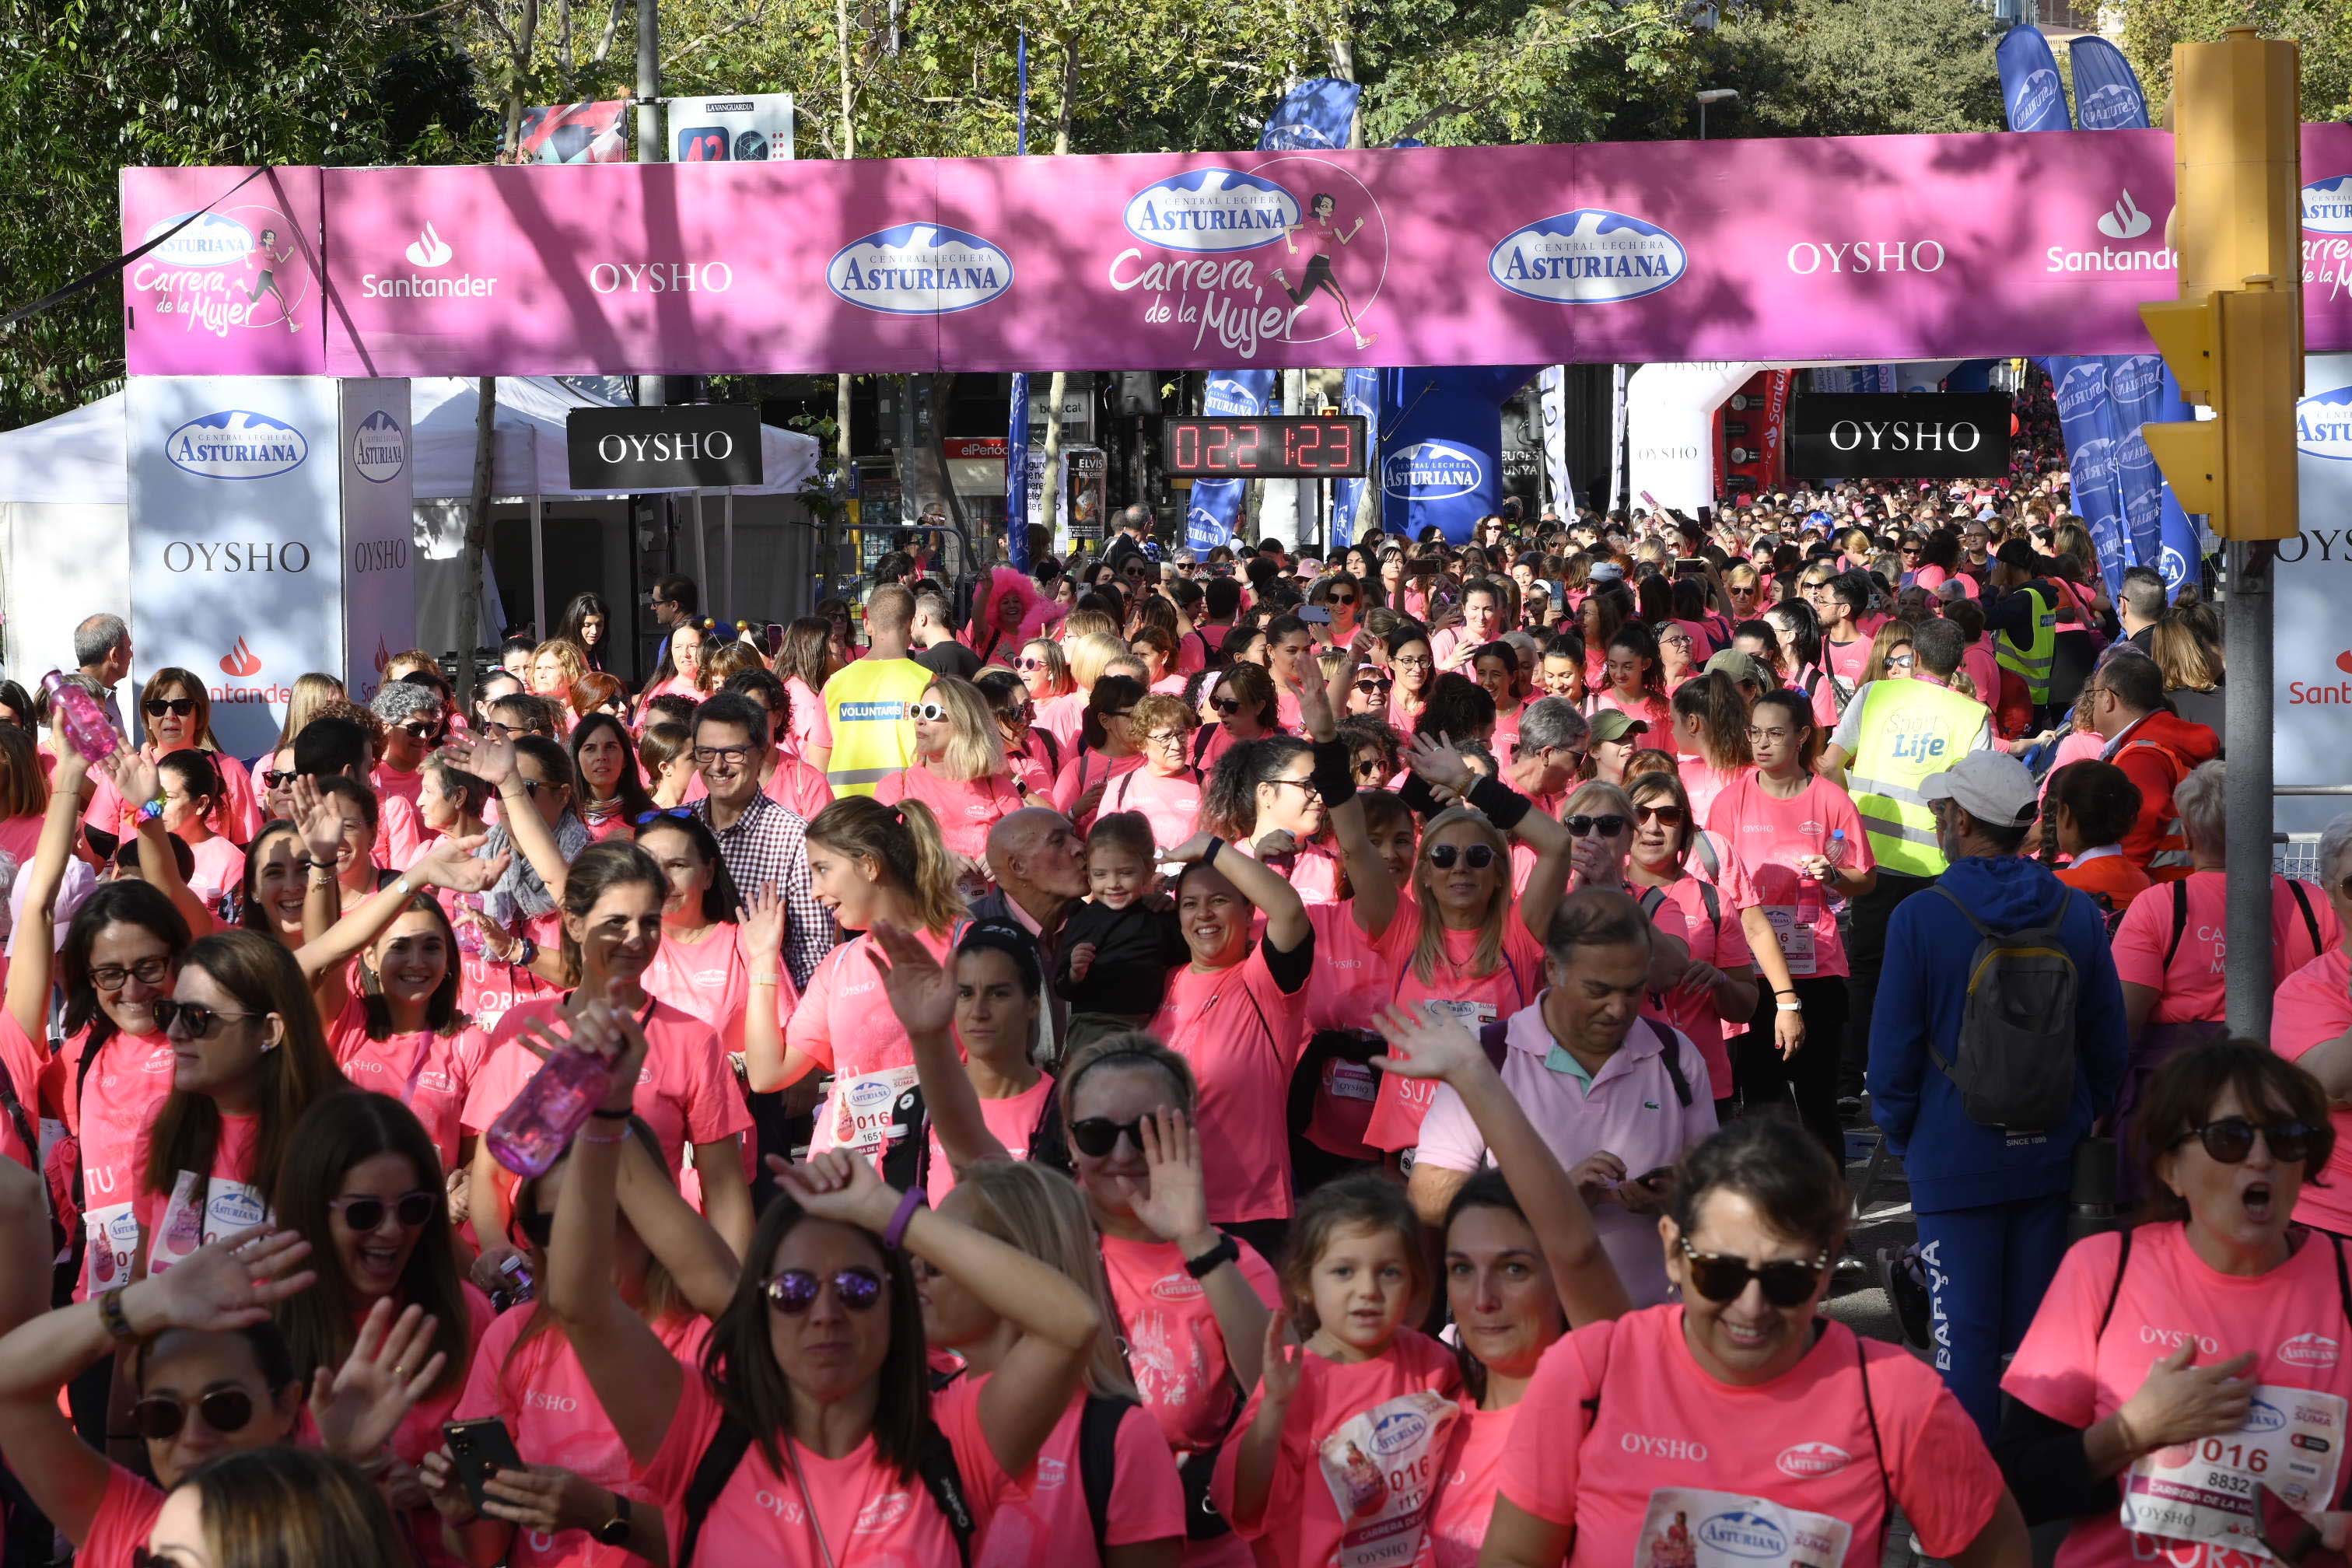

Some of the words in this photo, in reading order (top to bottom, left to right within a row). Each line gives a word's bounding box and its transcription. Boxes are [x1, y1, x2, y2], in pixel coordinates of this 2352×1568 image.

[1165, 197, 1222, 205] CENTRAL
[1226, 195, 1282, 205] LECHERA
[1138, 199, 1286, 232] ASTURIANA
[870, 254, 928, 264] CENTRAL
[933, 253, 993, 263] LECHERA
[1535, 241, 1597, 252] CENTRAL
[1602, 240, 1664, 250] LECHERA
[1788, 240, 1945, 274] OYSHO
[134, 262, 227, 292] Carrera
[590, 261, 733, 293] OYSHO
[841, 256, 999, 291] ASTURIANA
[1108, 247, 1254, 292] Carrera
[1503, 246, 1671, 280] ASTURIANA
[2319, 261, 2333, 282] la
[362, 274, 497, 298] Santander
[156, 294, 173, 313] de
[177, 292, 189, 313] la
[187, 289, 261, 337] Mujer
[1145, 298, 1172, 324] de
[1178, 292, 1196, 324] la
[1193, 285, 1310, 359] Mujer
[177, 436, 297, 462] ASTURIANA
[599, 430, 733, 464] OYSHO
[1830, 420, 1980, 453] OYSHO
[357, 438, 402, 466] ASTURIANA
[1079, 458, 1102, 468] ELVIS
[1639, 446, 1697, 460] OYSHO
[1387, 467, 1474, 488] ASTURIANA
[163, 541, 310, 572] OYSHO
[355, 538, 406, 573] OYSHO
[1892, 732, 1945, 765] Life
[1743, 825, 1773, 834] OYSHO
[852, 1090, 887, 1102] ASTURIANA
[2005, 1138, 2028, 1146] SINCE
[85, 1166, 114, 1195] TU
[212, 1203, 258, 1222] ASTURIANA
[2140, 1325, 2218, 1355] OYSO
[2295, 1411, 2332, 1427] SUMA
[1622, 1432, 1707, 1462] OYSHO
[2203, 1438, 2270, 1473] 016
[2151, 1480, 2201, 1502] CARRERA
[2203, 1493, 2220, 1505] DE
[2221, 1498, 2235, 1511] LA
[2208, 1472, 2249, 1493] 8832
[2140, 1505, 2196, 1528] OYSHO
[1706, 1525, 1781, 1552] ASTURIANA
[1356, 1542, 1408, 1565] OYSHO
